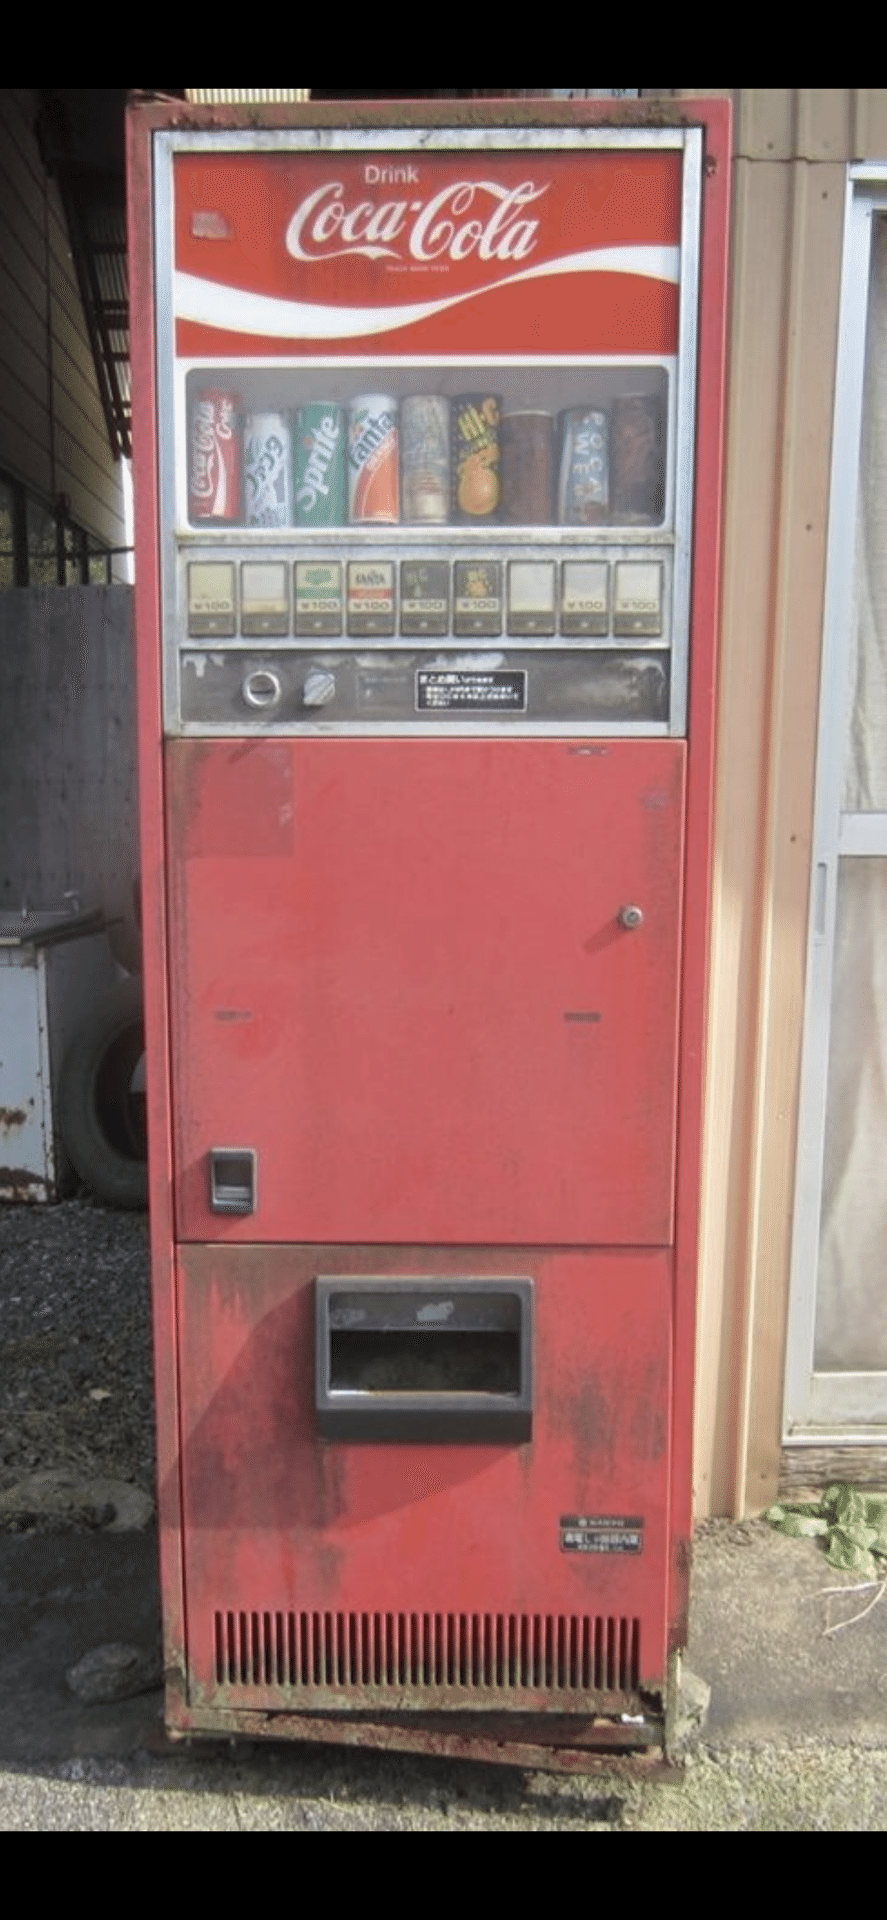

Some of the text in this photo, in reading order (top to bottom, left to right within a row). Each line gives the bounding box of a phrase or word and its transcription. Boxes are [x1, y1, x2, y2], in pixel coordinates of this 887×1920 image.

[364, 164, 420, 185] Drink
[285, 181, 552, 262] Coca-Cola
[296, 416, 340, 512] Sprite
[301, 601, 337, 610] ¥100
[354, 601, 390, 610] ¥100
[462, 600, 496, 609] ¥100
[567, 600, 603, 609] ¥100
